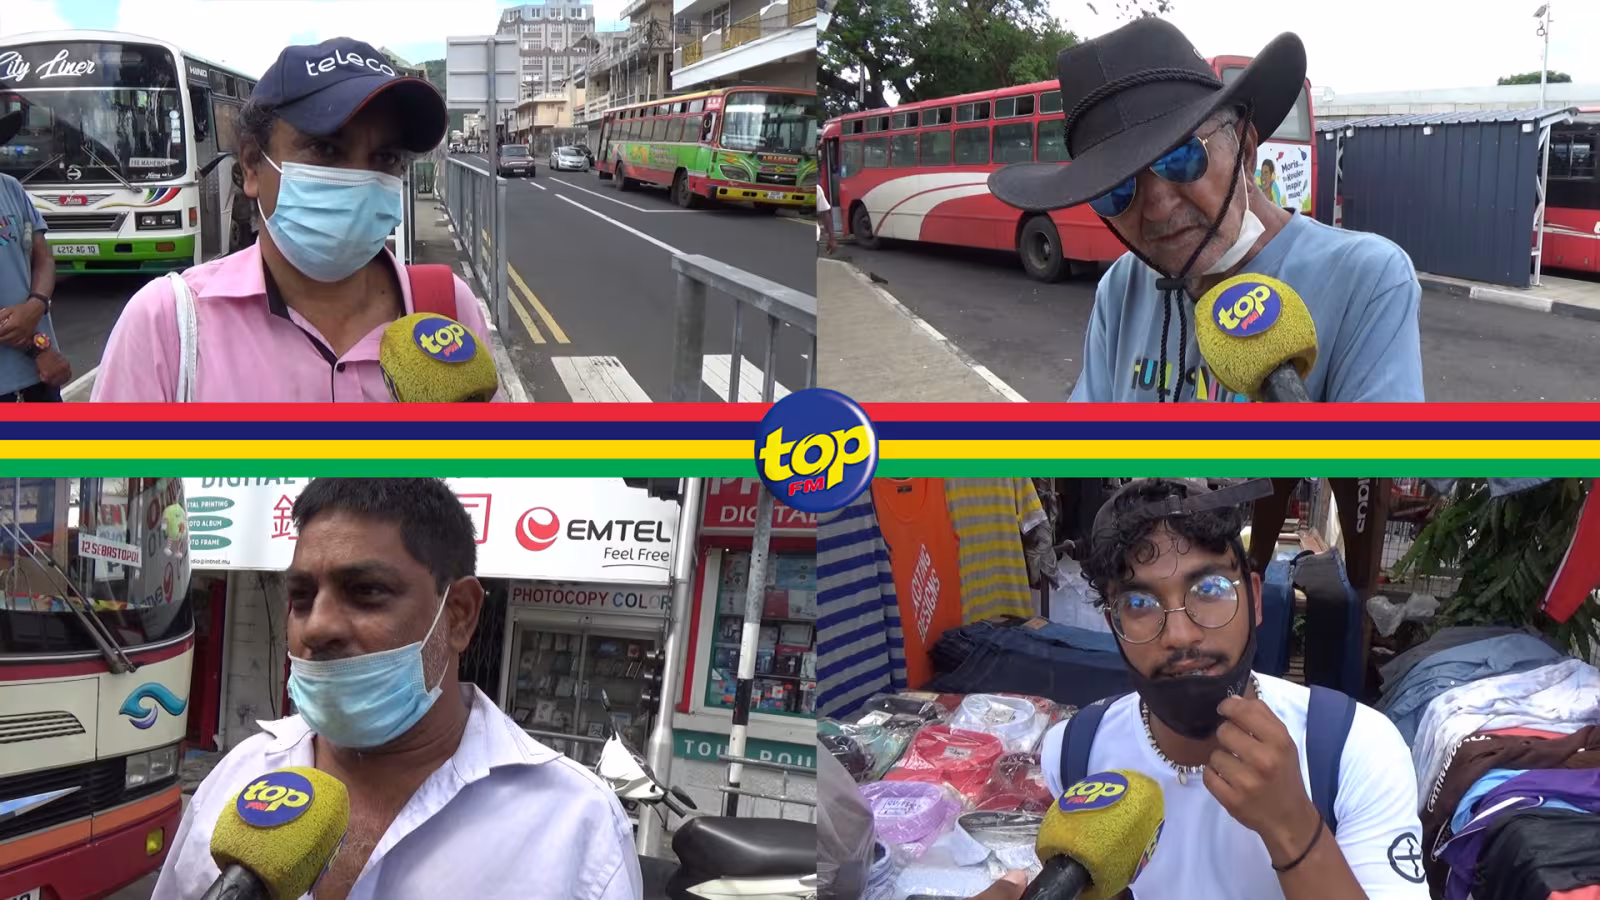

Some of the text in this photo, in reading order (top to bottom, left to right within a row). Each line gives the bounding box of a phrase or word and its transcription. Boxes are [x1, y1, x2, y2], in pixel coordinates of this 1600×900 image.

[0, 49, 96, 82] City Liner
[189, 65, 207, 77] HINO
[1218, 285, 1271, 330] top
[419, 323, 465, 354] top
[201, 519, 223, 527] ALBUM
[566, 519, 672, 543] EMTEL
[81, 540, 91, 554] 12
[200, 538, 220, 546] FRAME
[603, 547, 670, 562] Feel Free
[512, 587, 610, 607] PHOTOCOPY
[684, 739, 730, 758] TOU
[243, 780, 310, 812] top
[1063, 781, 1126, 805] top
